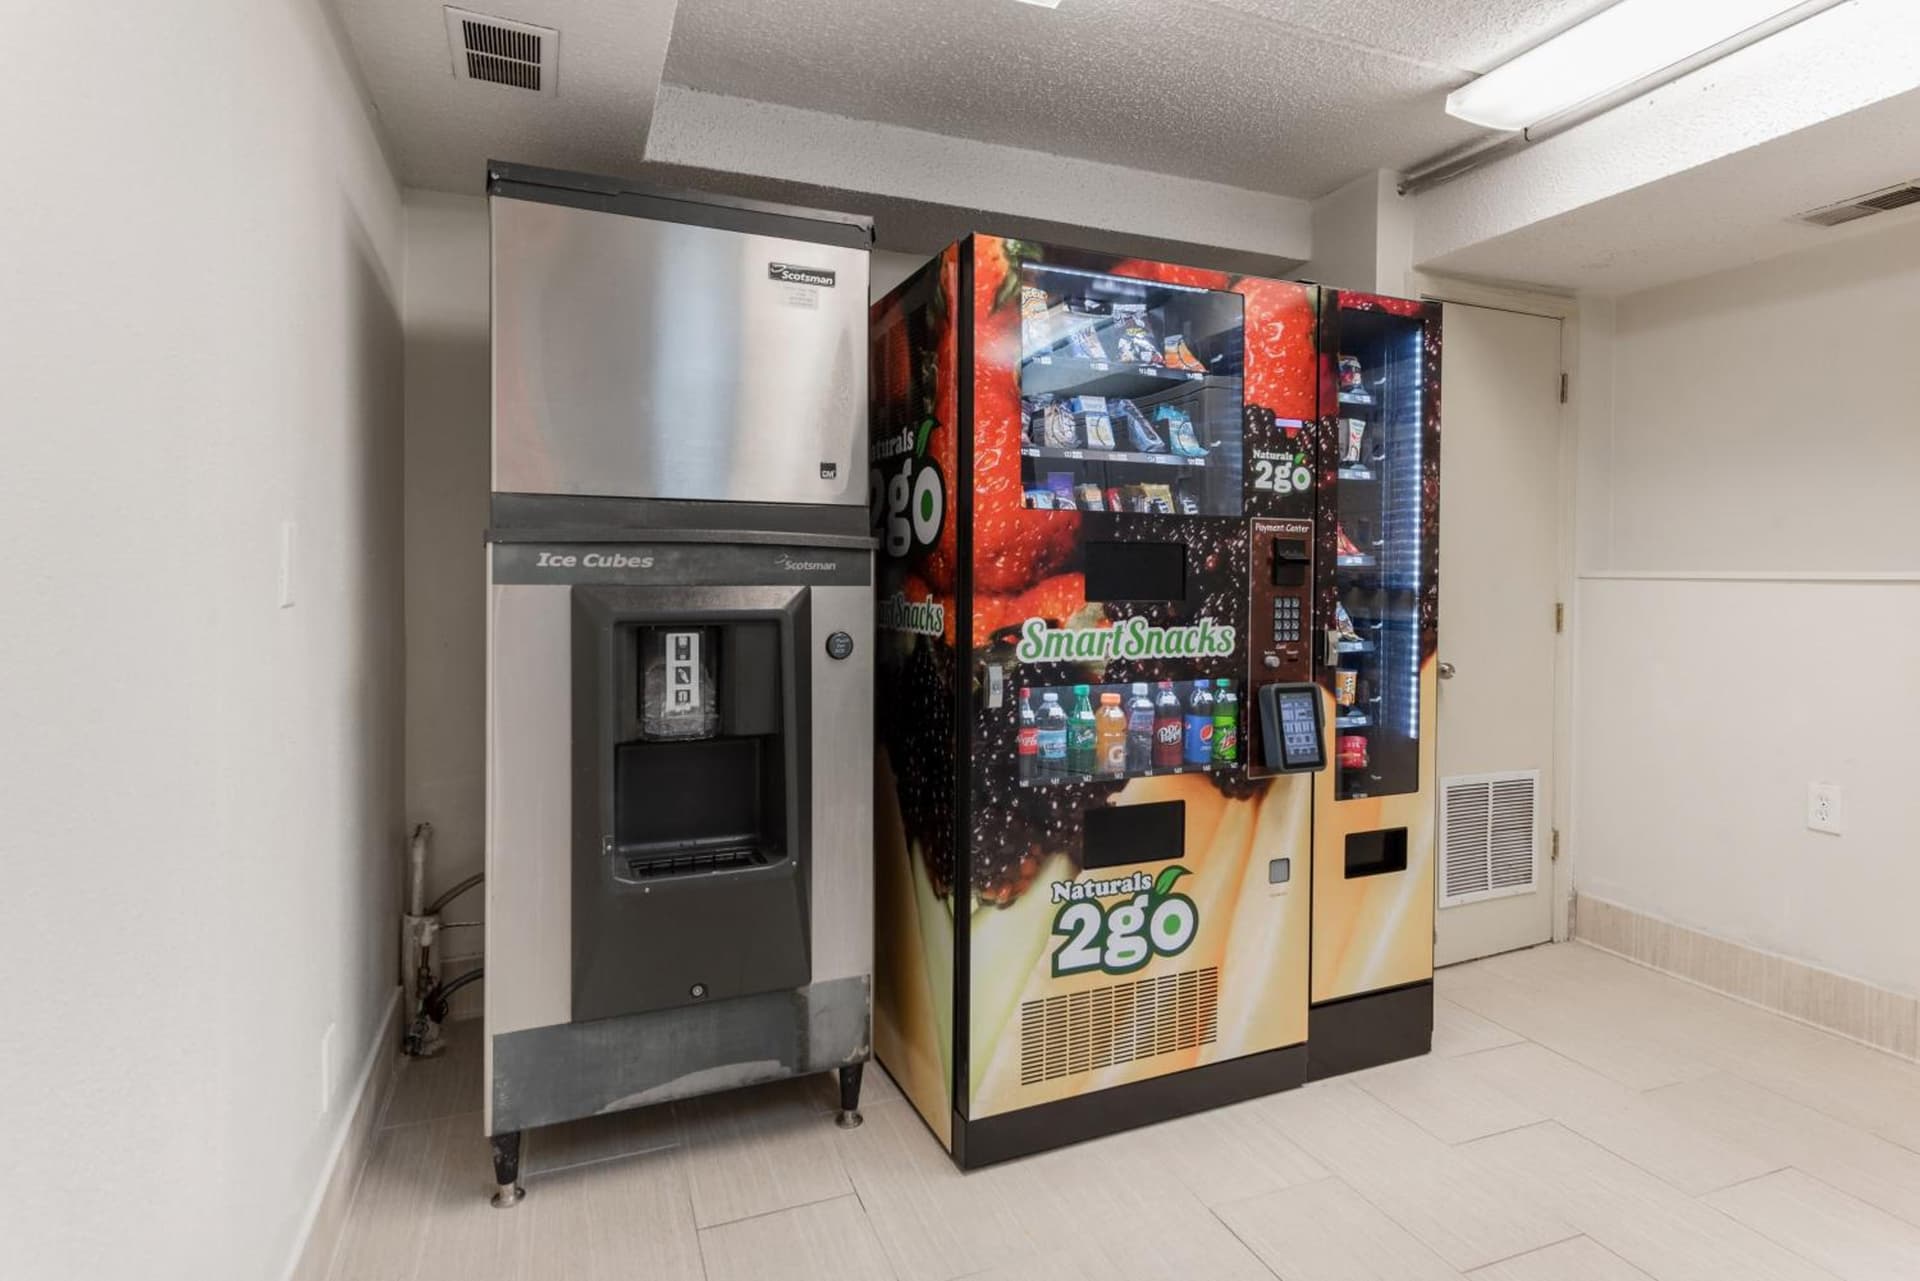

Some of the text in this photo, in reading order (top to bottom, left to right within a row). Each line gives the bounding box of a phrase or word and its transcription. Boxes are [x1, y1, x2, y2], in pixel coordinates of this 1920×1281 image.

[781, 270, 833, 285] Scotsman
[872, 427, 914, 460] turals
[1252, 449, 1294, 461] Naturals
[1255, 460, 1311, 493] 2go
[1255, 522, 1310, 534] Payment Center
[536, 552, 655, 568] Ice Cubes
[784, 560, 836, 571] Scotsman
[1019, 617, 1235, 661] SmartSnacks
[1052, 872, 1152, 903] Naturals
[1055, 895, 1196, 974] 2go
